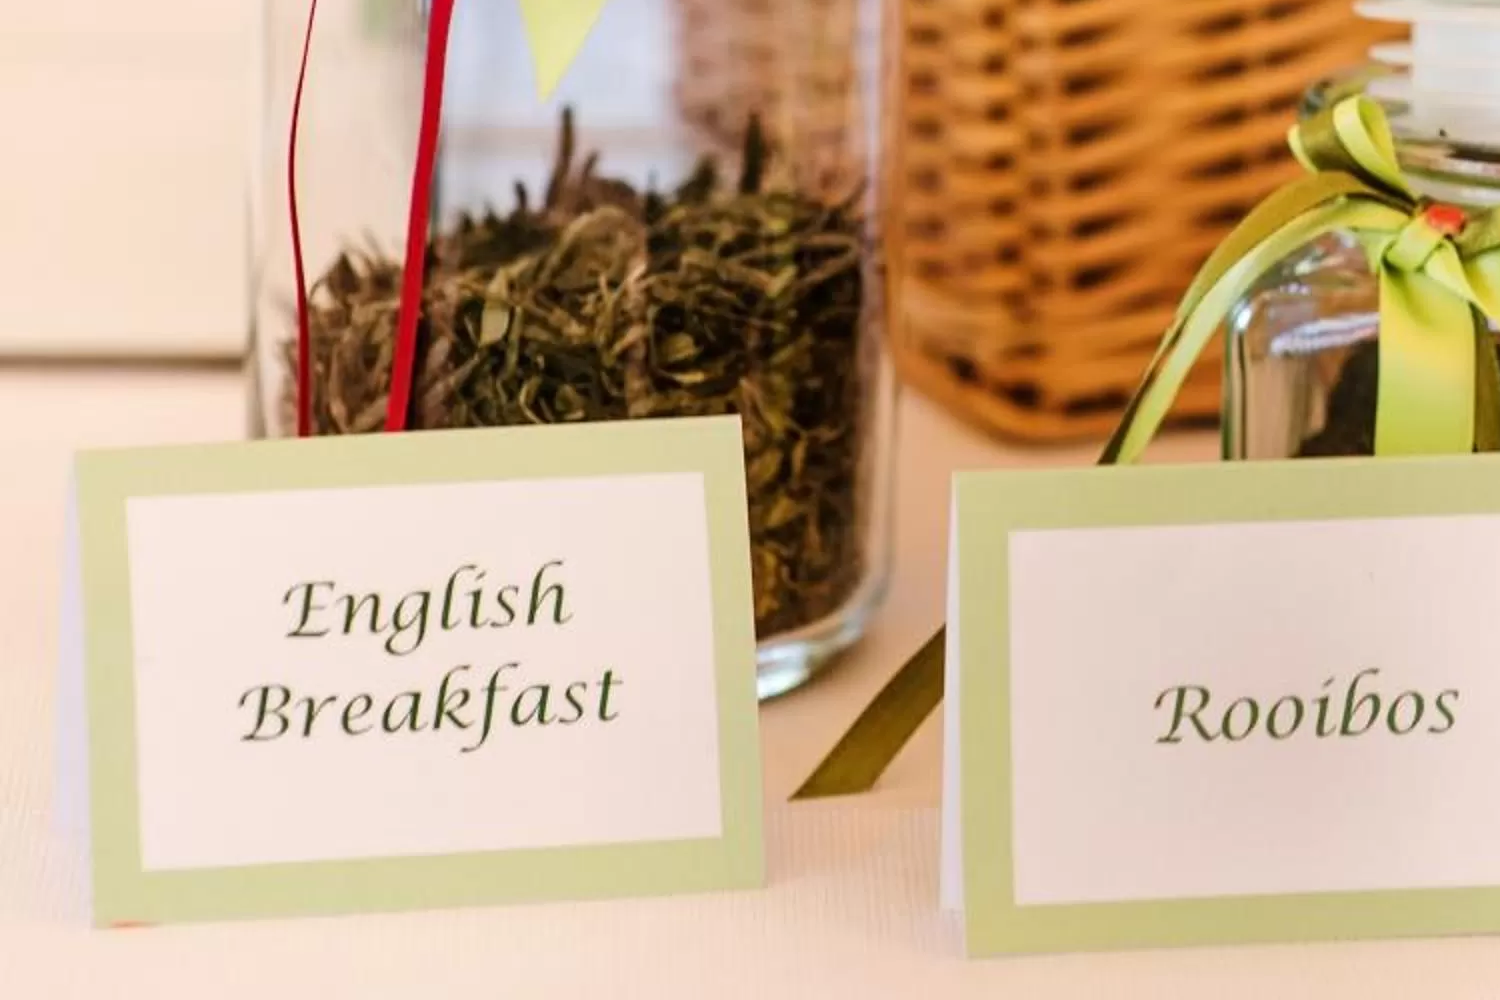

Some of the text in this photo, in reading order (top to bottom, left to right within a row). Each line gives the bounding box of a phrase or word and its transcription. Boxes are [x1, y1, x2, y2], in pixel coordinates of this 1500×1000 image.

[282, 560, 573, 657] English
[238, 662, 624, 753] Breakfast
[1153, 668, 1460, 745] Rooibos
